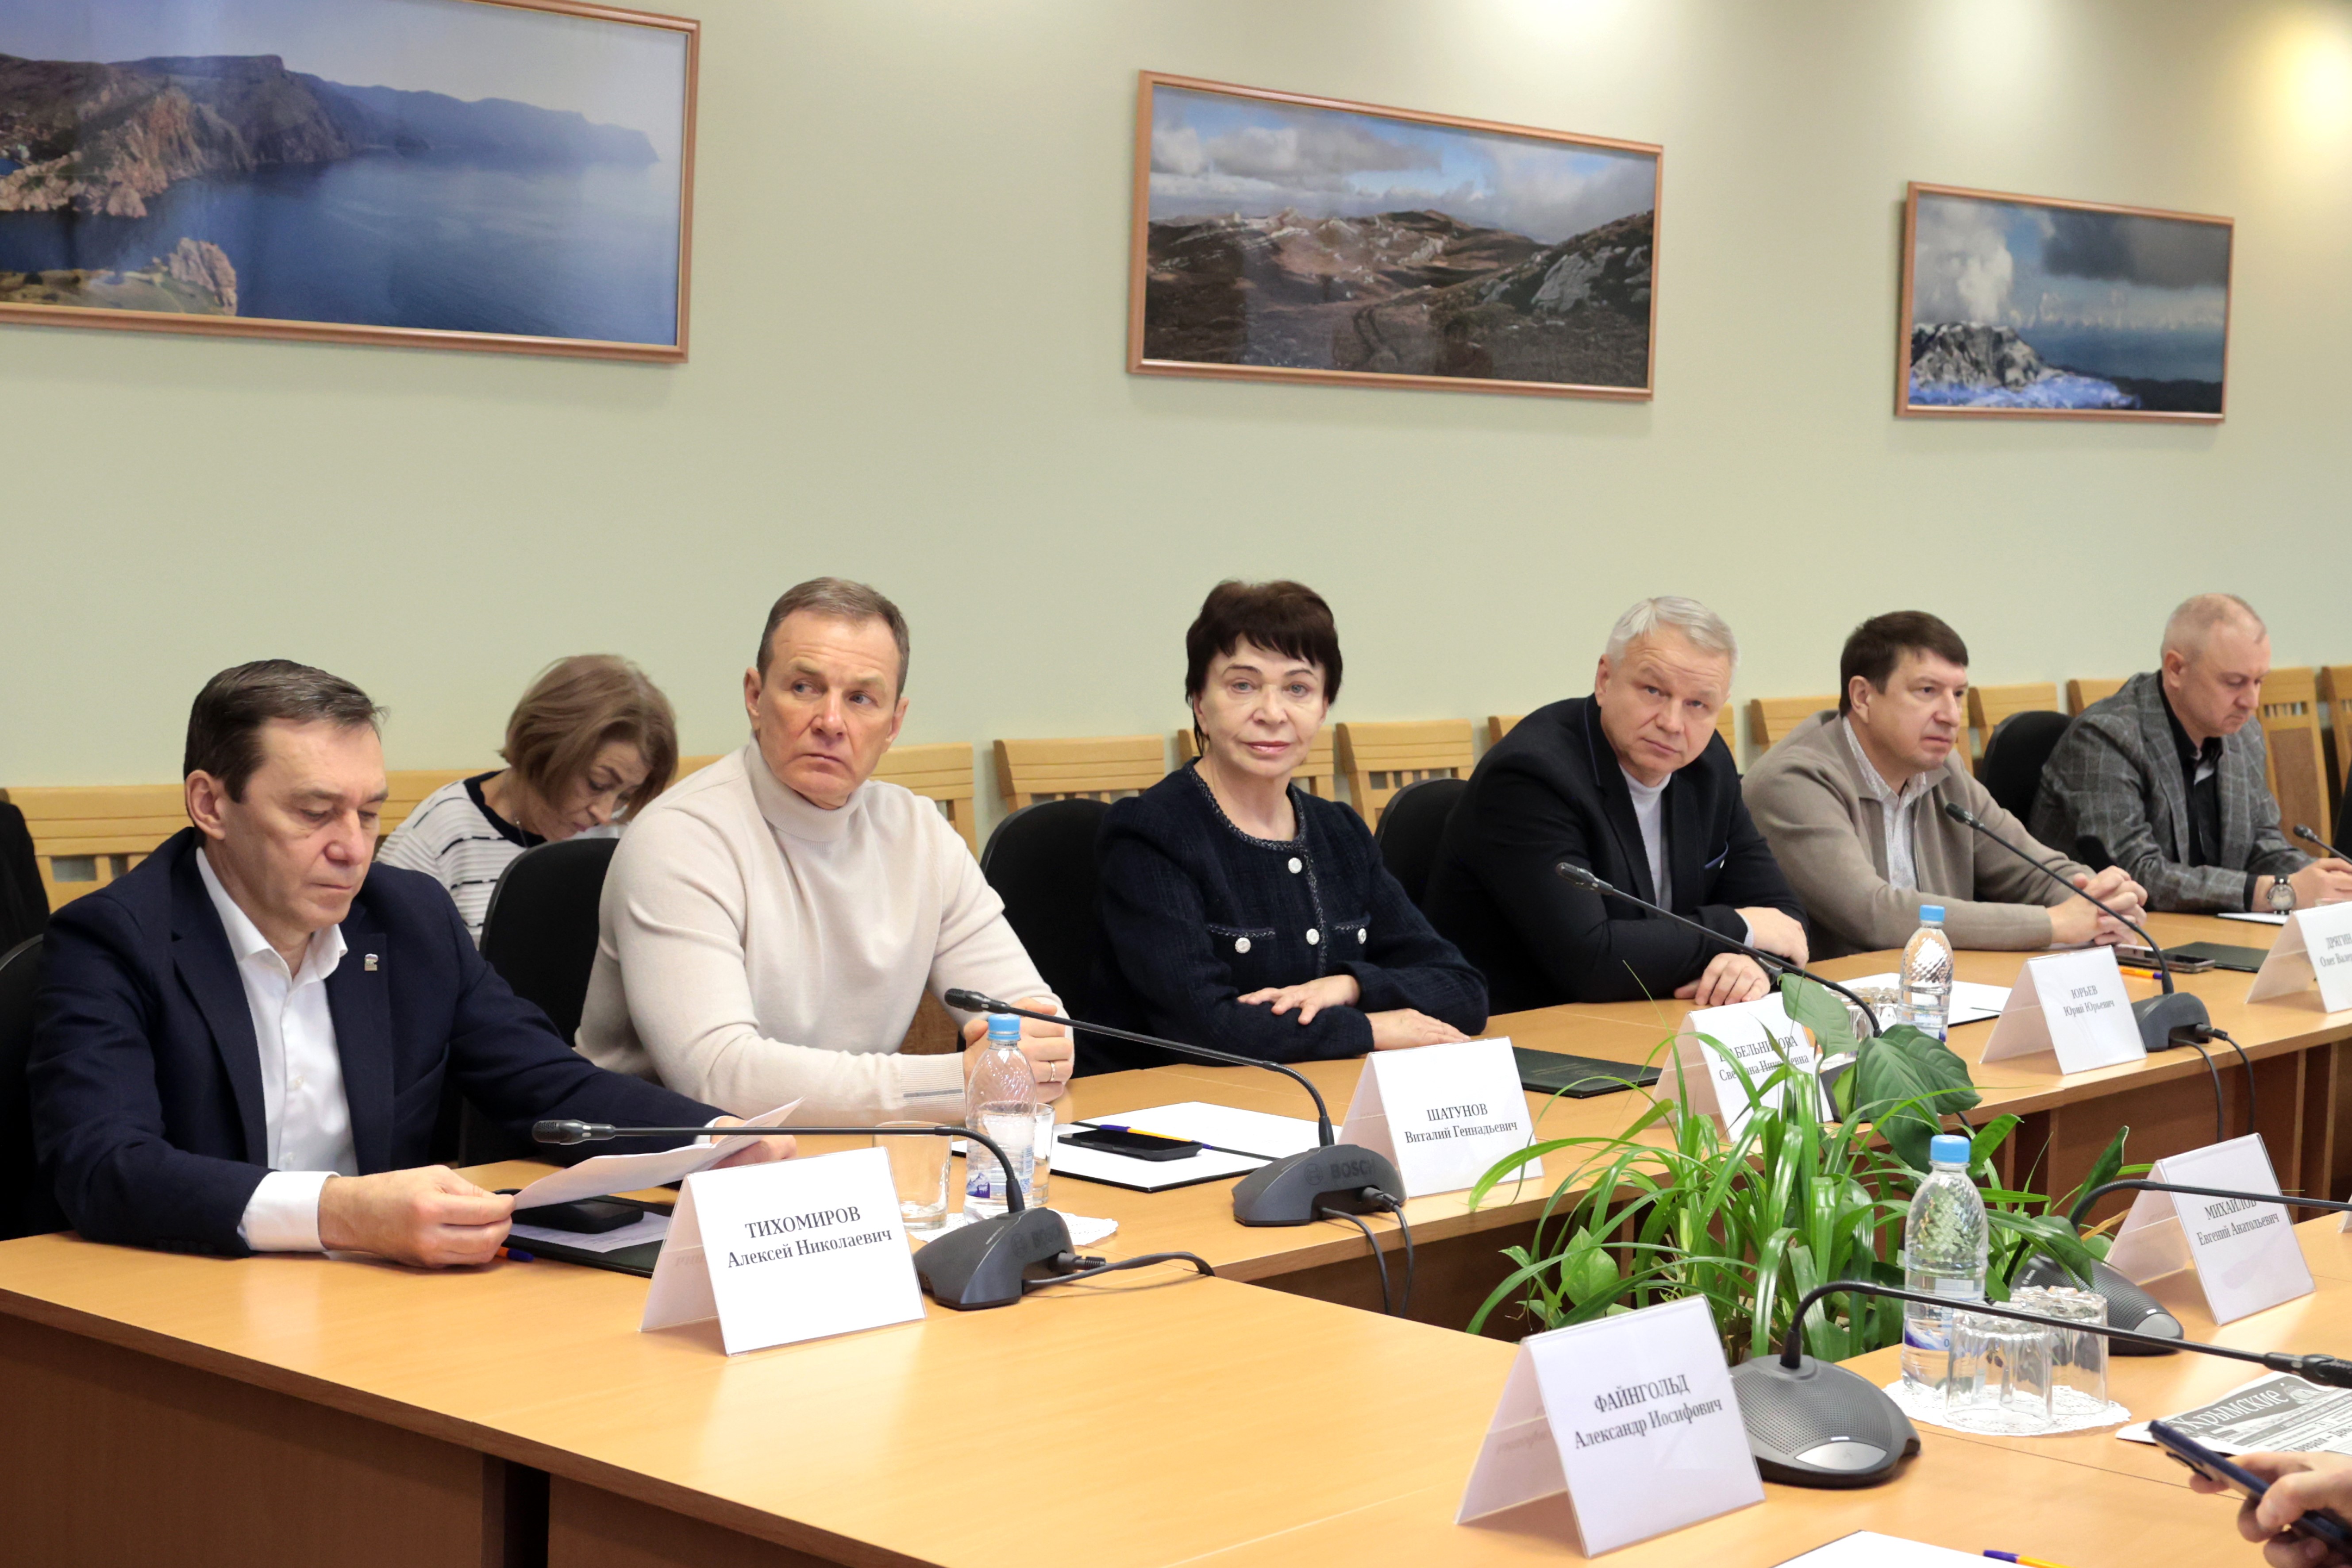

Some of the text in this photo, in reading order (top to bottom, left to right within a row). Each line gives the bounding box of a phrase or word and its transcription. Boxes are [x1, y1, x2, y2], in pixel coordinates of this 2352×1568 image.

[2319, 956, 2336, 967] Олег
[2071, 985, 2098, 999] ЮРЬЕВ
[2063, 1000, 2115, 1017] Юрий Юрьевич
[1719, 1036, 1798, 1062] БЕЛЬНИОВА
[1719, 1055, 1809, 1081] Свеана Никоевна
[1426, 1103, 1488, 1121] ШАТУНОВ
[1405, 1121, 1518, 1144] Виталий Геннадьевич
[744, 1206, 861, 1239] ТИХОМИРОВ
[2196, 1213, 2280, 1246] Евгений Анатольевич
[728, 1243, 793, 1268] Алексей
[797, 1229, 893, 1257] Николаевич
[1594, 1374, 1691, 1414] ФАЙНГОЛЬД
[1575, 1419, 1647, 1449] Александр
[1648, 1398, 1723, 1429] Иосифович
